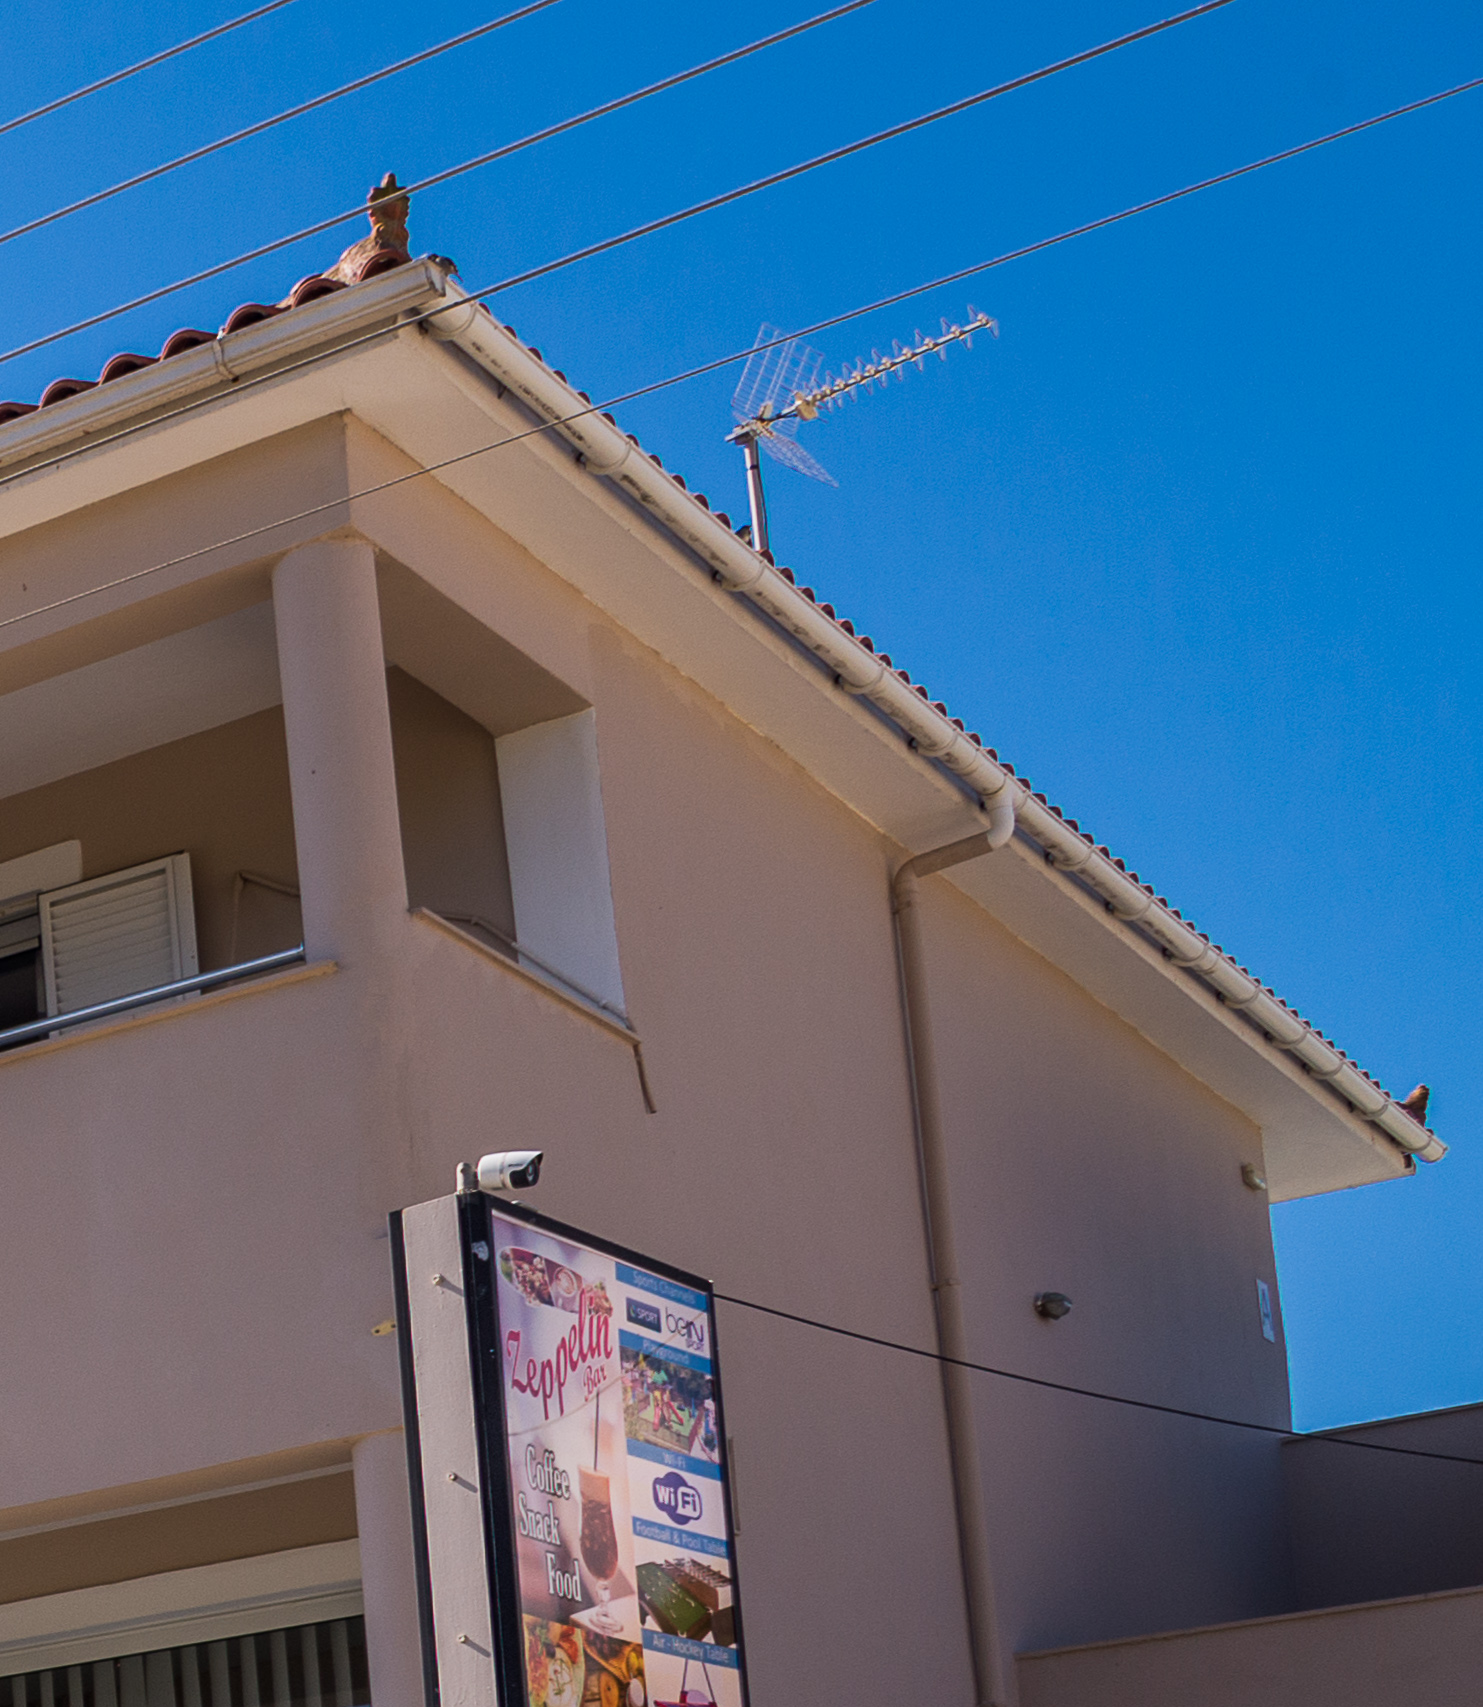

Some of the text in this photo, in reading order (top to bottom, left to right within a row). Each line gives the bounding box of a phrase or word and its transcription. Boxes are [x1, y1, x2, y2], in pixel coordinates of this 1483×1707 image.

[633, 1269, 696, 1305] Sports Channels
[506, 1287, 613, 1420] Zeppelin
[643, 1340, 690, 1364] Playground
[583, 1363, 607, 1402] Bar
[525, 1443, 570, 1500] Coffee
[662, 1452, 686, 1468] Wi-Fi
[518, 1491, 561, 1546] Snack
[635, 1521, 671, 1541] Football
[673, 1531, 680, 1545] &
[682, 1533, 702, 1550] Pool
[546, 1551, 582, 1602] Food
[653, 1634, 665, 1648] Air
[673, 1638, 704, 1660] Hockey
[705, 1645, 729, 1660] Table
